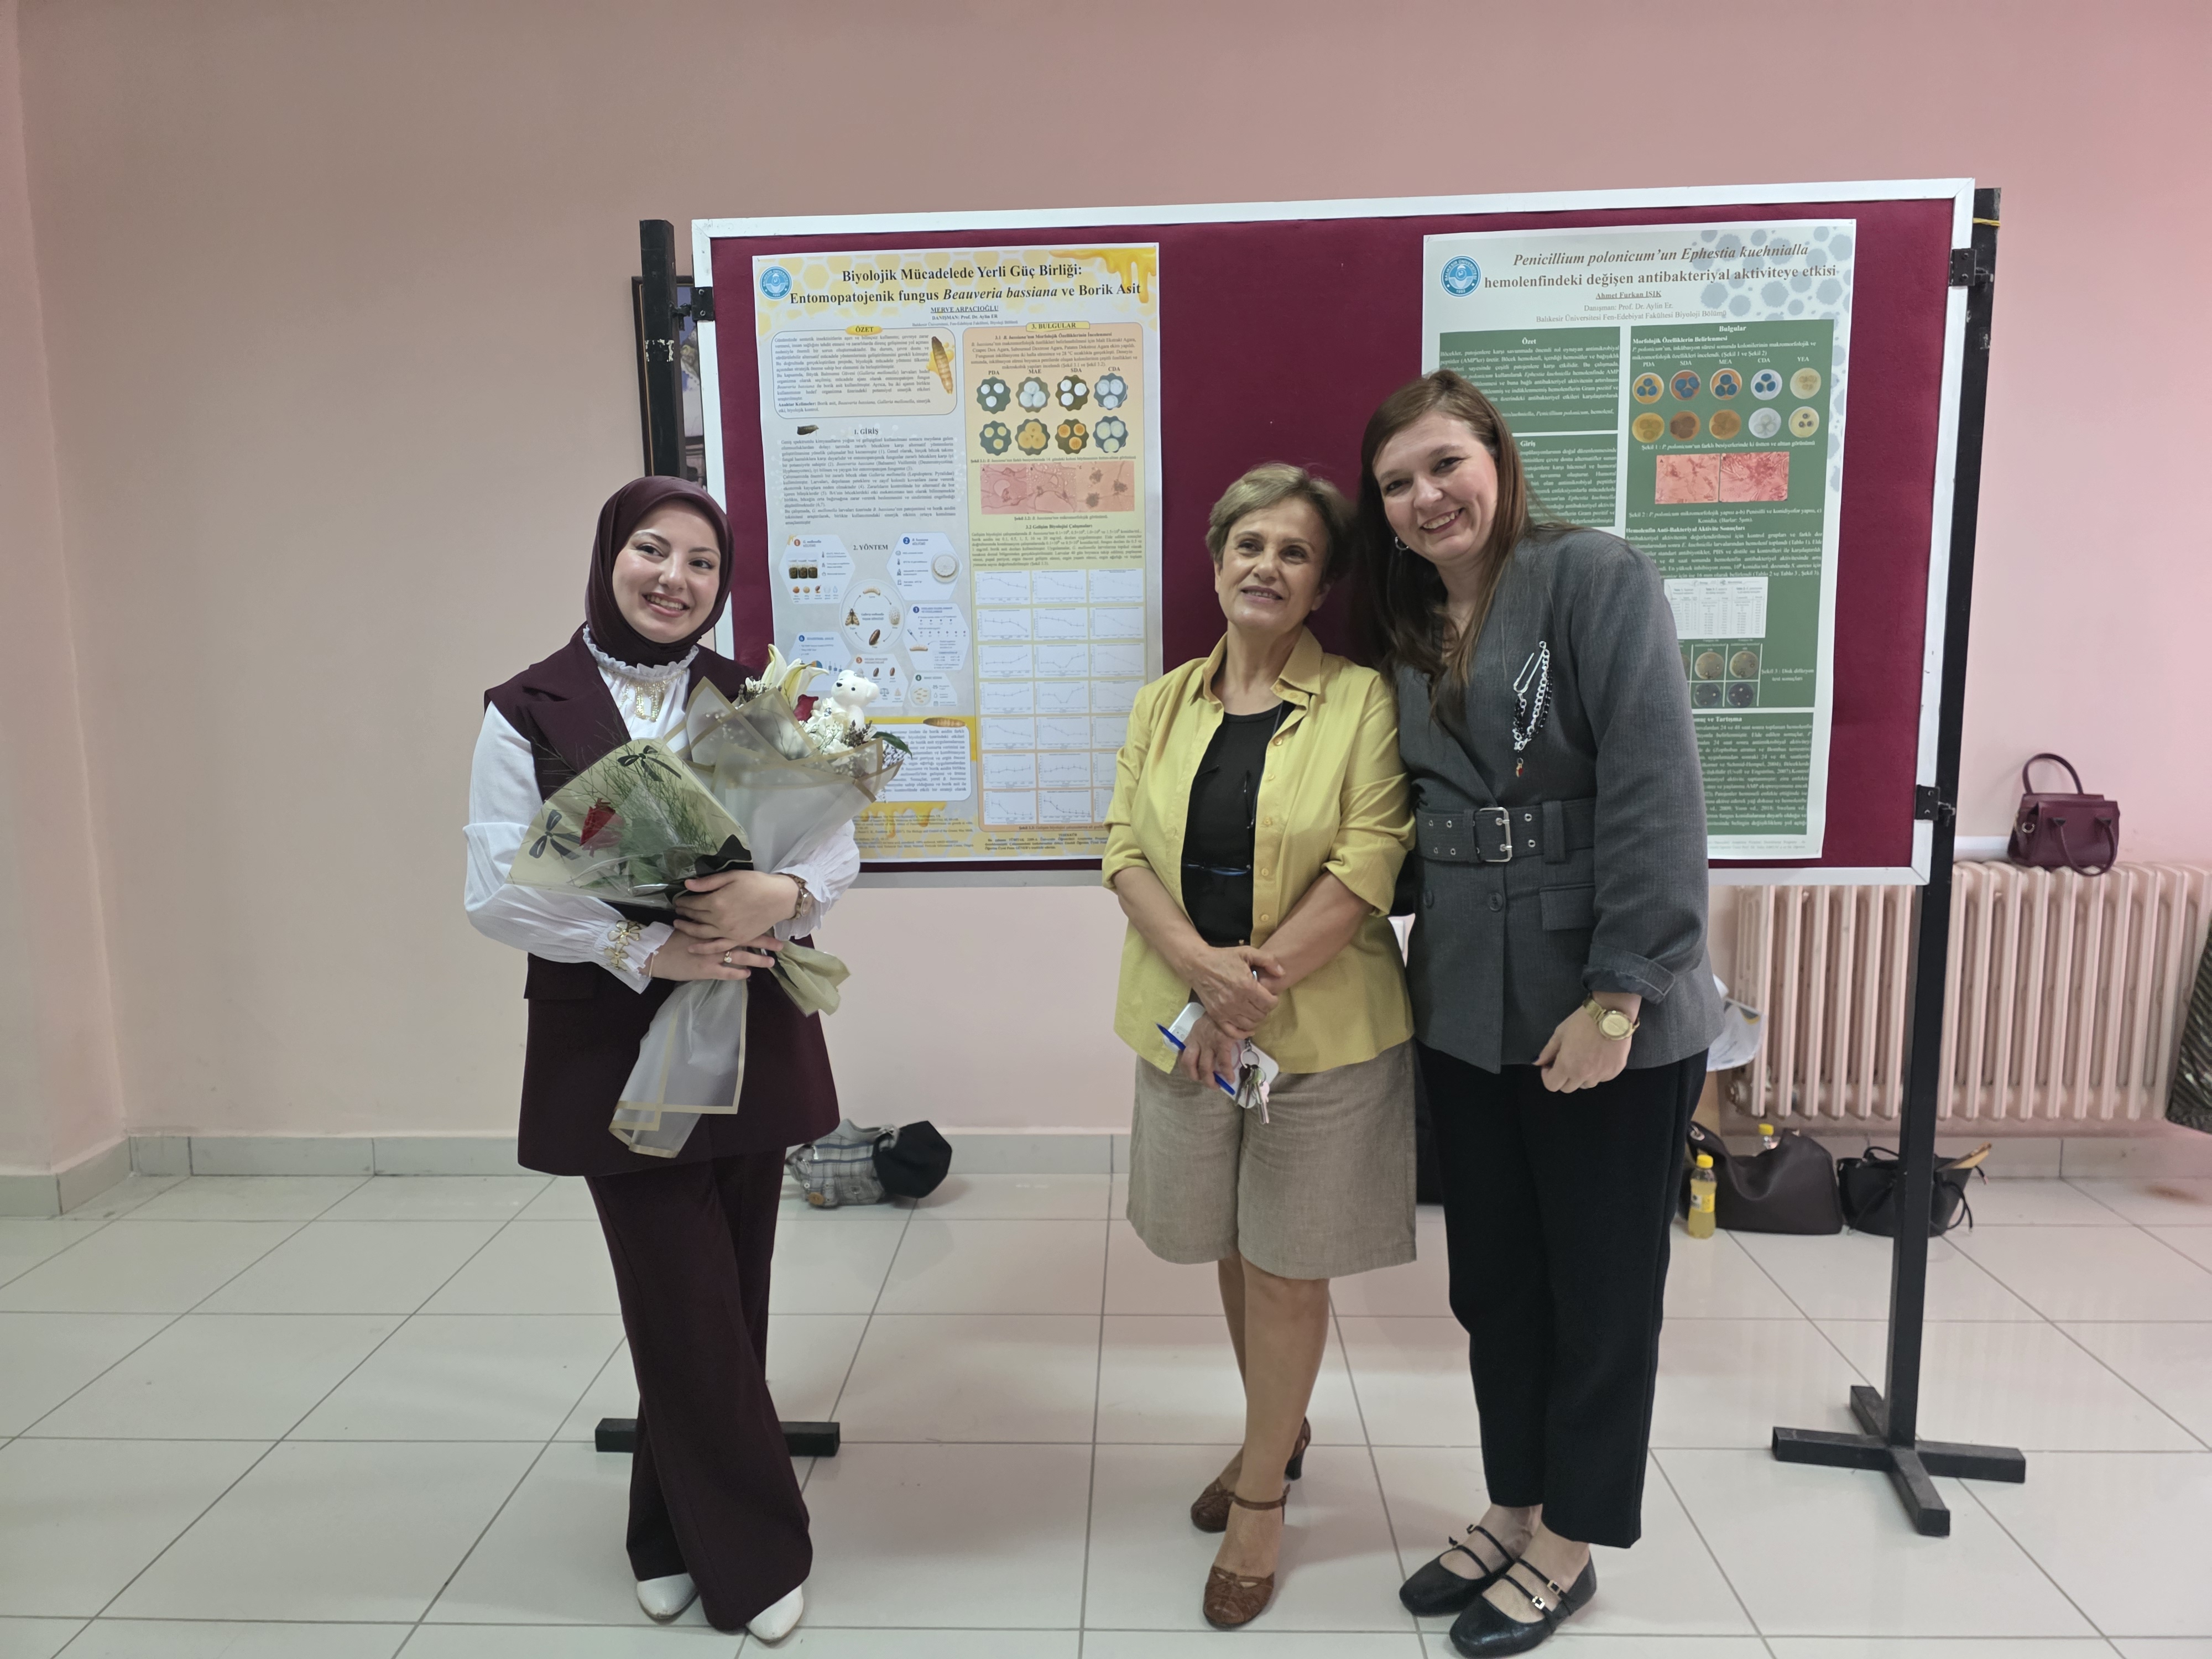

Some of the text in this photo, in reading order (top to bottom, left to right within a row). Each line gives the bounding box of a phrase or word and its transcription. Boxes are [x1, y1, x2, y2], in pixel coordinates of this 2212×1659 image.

[1514, 244, 1809, 264] Penicillium polonicum'un Ephestia kuehnialla
[843, 264, 1081, 284] Biyolojik Mücadelede Yerli Güç Birliği:
[1485, 265, 1837, 286] hemolenfindeki değişen antibakteriyal aktiviteye etkisi
[790, 291, 894, 305] Entomopatojenik
[899, 290, 938, 303] fungus
[943, 288, 1002, 299] Beauveria
[1006, 286, 1057, 297] bassiana
[1079, 284, 1113, 295] Borik
[1117, 283, 1140, 294] Asit
